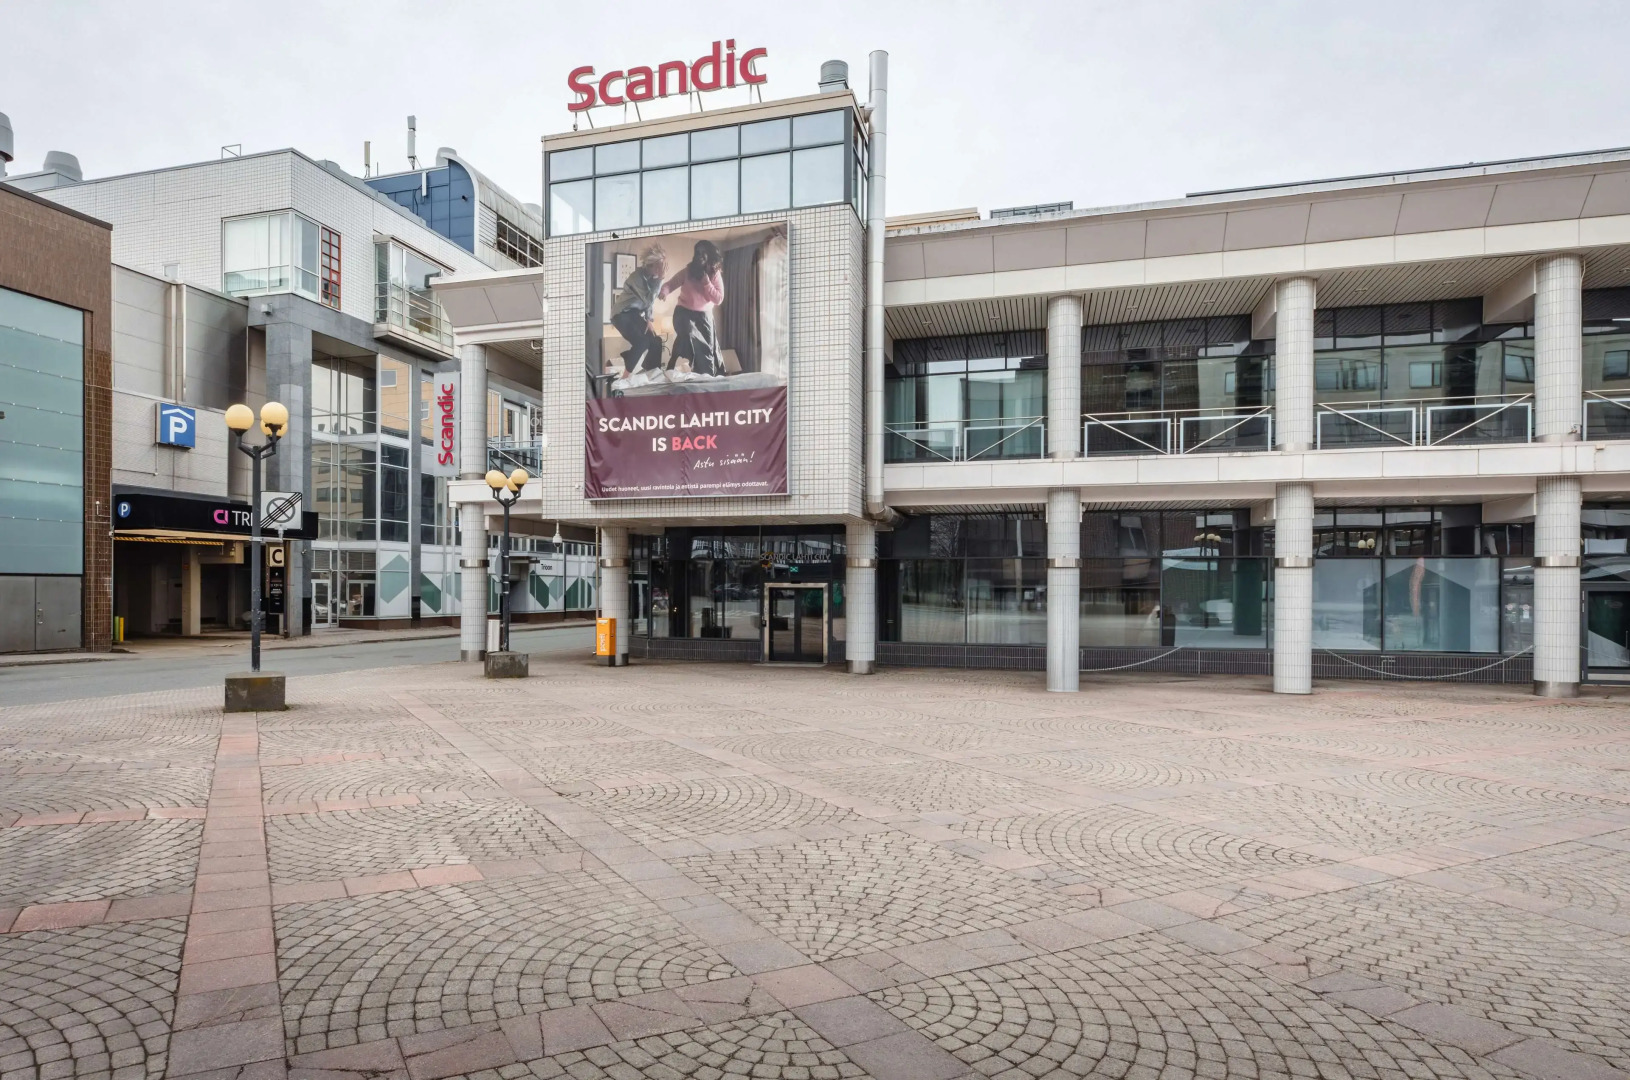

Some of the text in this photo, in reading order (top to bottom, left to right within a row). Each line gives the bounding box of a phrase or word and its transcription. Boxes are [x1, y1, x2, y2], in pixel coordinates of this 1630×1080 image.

[567, 38, 767, 112] Scandic
[169, 415, 188, 443] P
[437, 383, 454, 466] Scandic
[599, 408, 773, 432] SCANDIC LAHTI CITY
[652, 434, 718, 452] IS BACK
[693, 451, 756, 470] Astu sisään!
[232, 510, 252, 527] TRI
[272, 548, 283, 564] C
